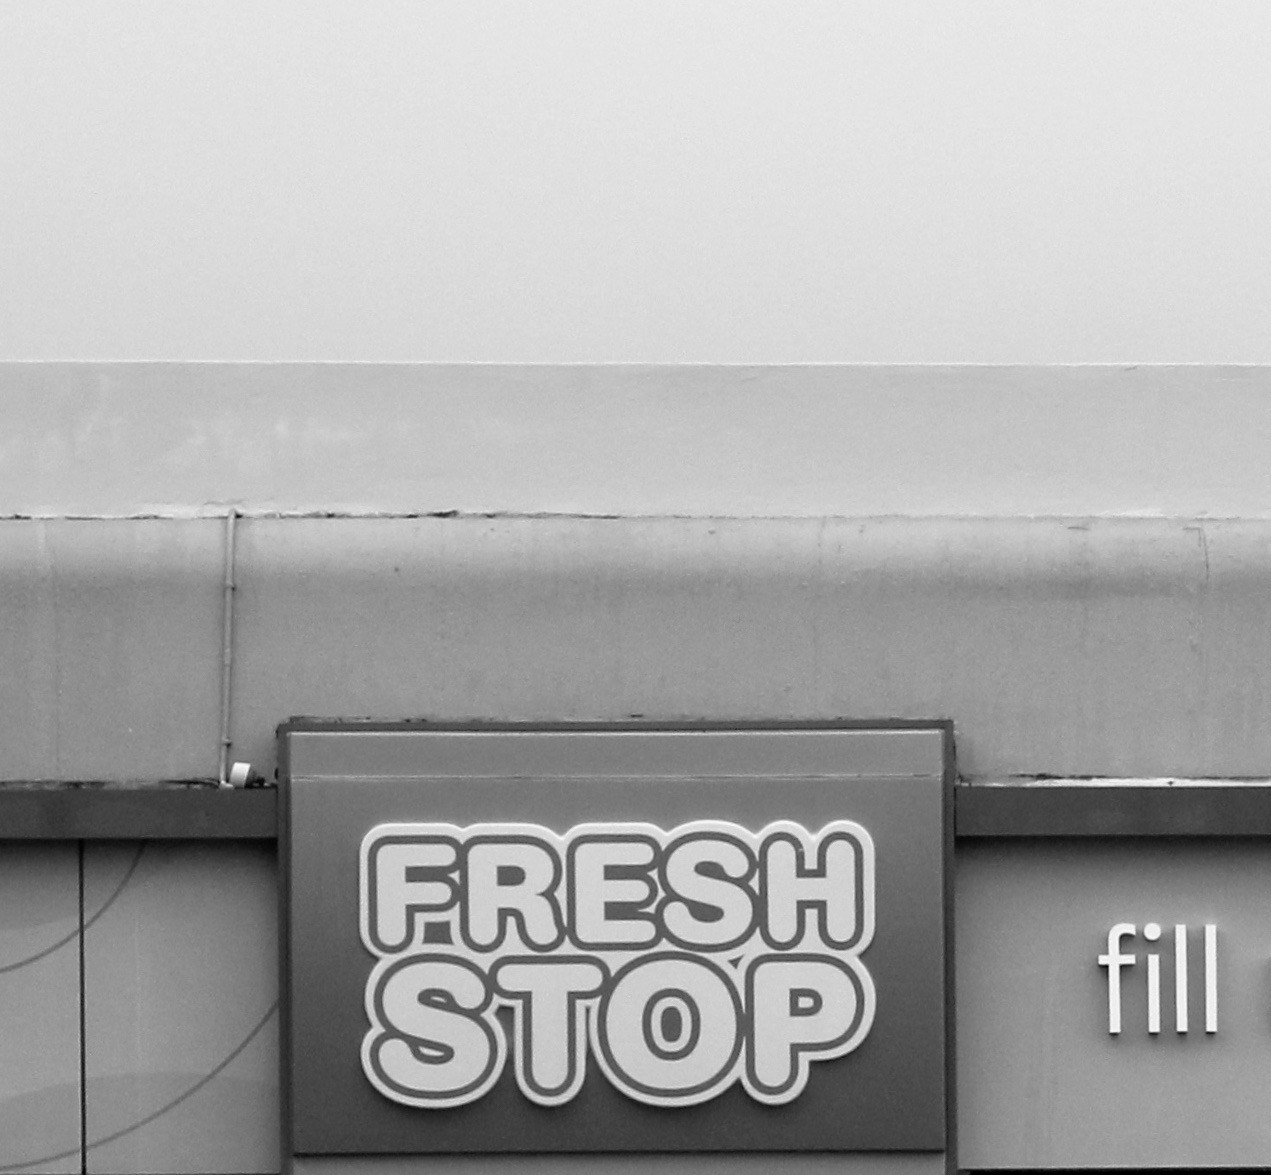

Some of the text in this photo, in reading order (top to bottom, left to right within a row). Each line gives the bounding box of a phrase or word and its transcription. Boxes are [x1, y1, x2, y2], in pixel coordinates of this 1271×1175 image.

[361, 820, 876, 957] FRESH
[361, 953, 876, 1108] STOP
[1097, 919, 1218, 1033] fill
